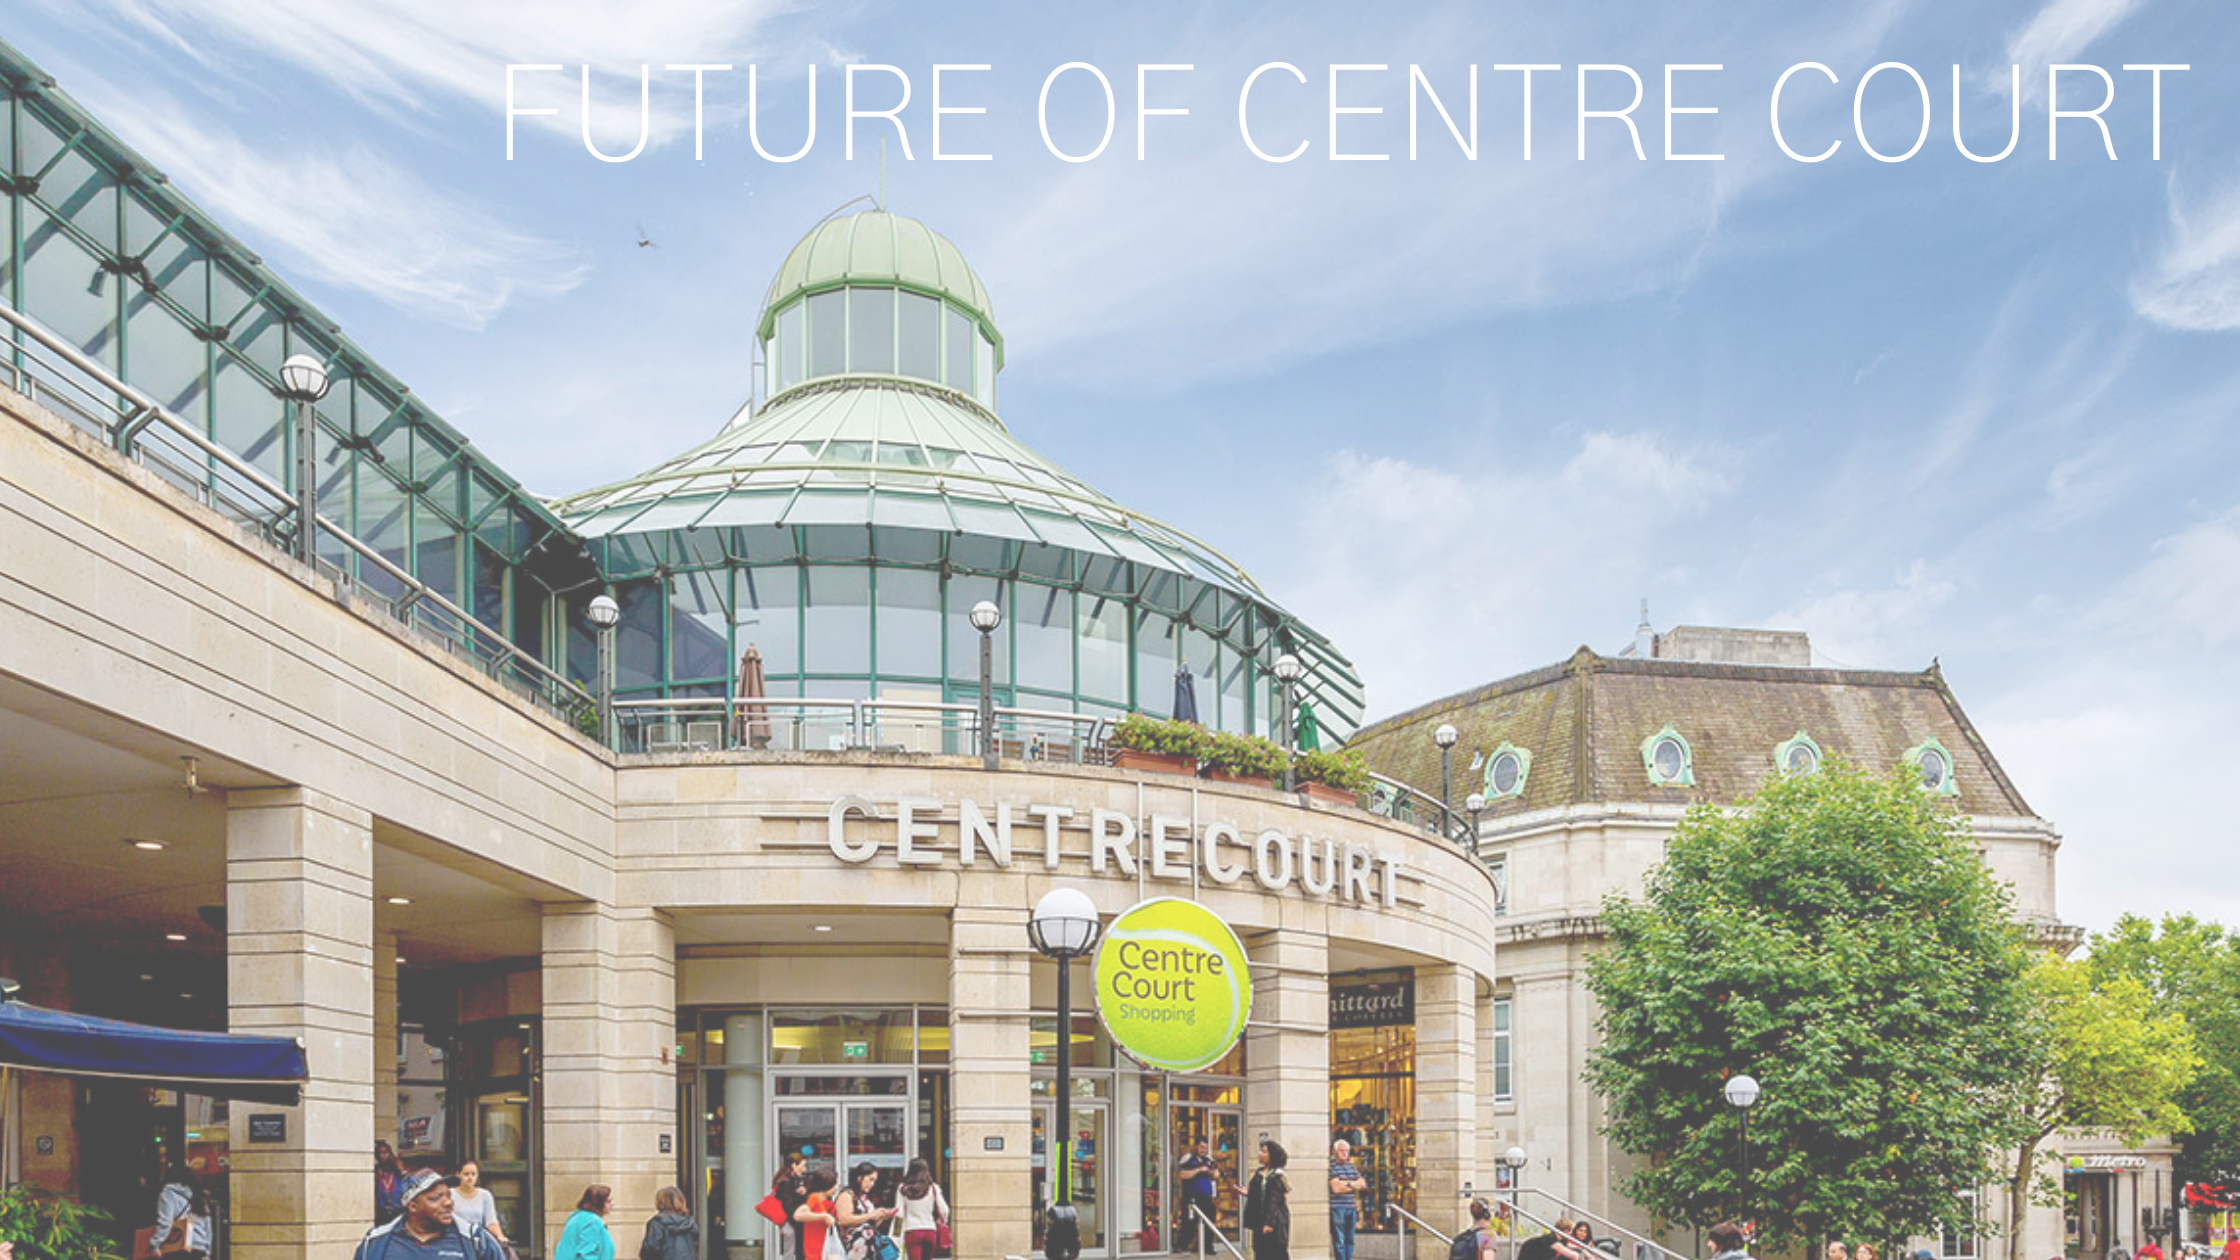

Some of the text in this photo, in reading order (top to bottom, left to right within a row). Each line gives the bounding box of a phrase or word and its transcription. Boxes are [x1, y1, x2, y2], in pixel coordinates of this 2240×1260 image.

[828, 794, 1399, 908] CENTRECOURT
[1119, 941, 1223, 976] Centre
[1112, 971, 1195, 1001] Court
[1119, 1003, 1196, 1026] Shopping
